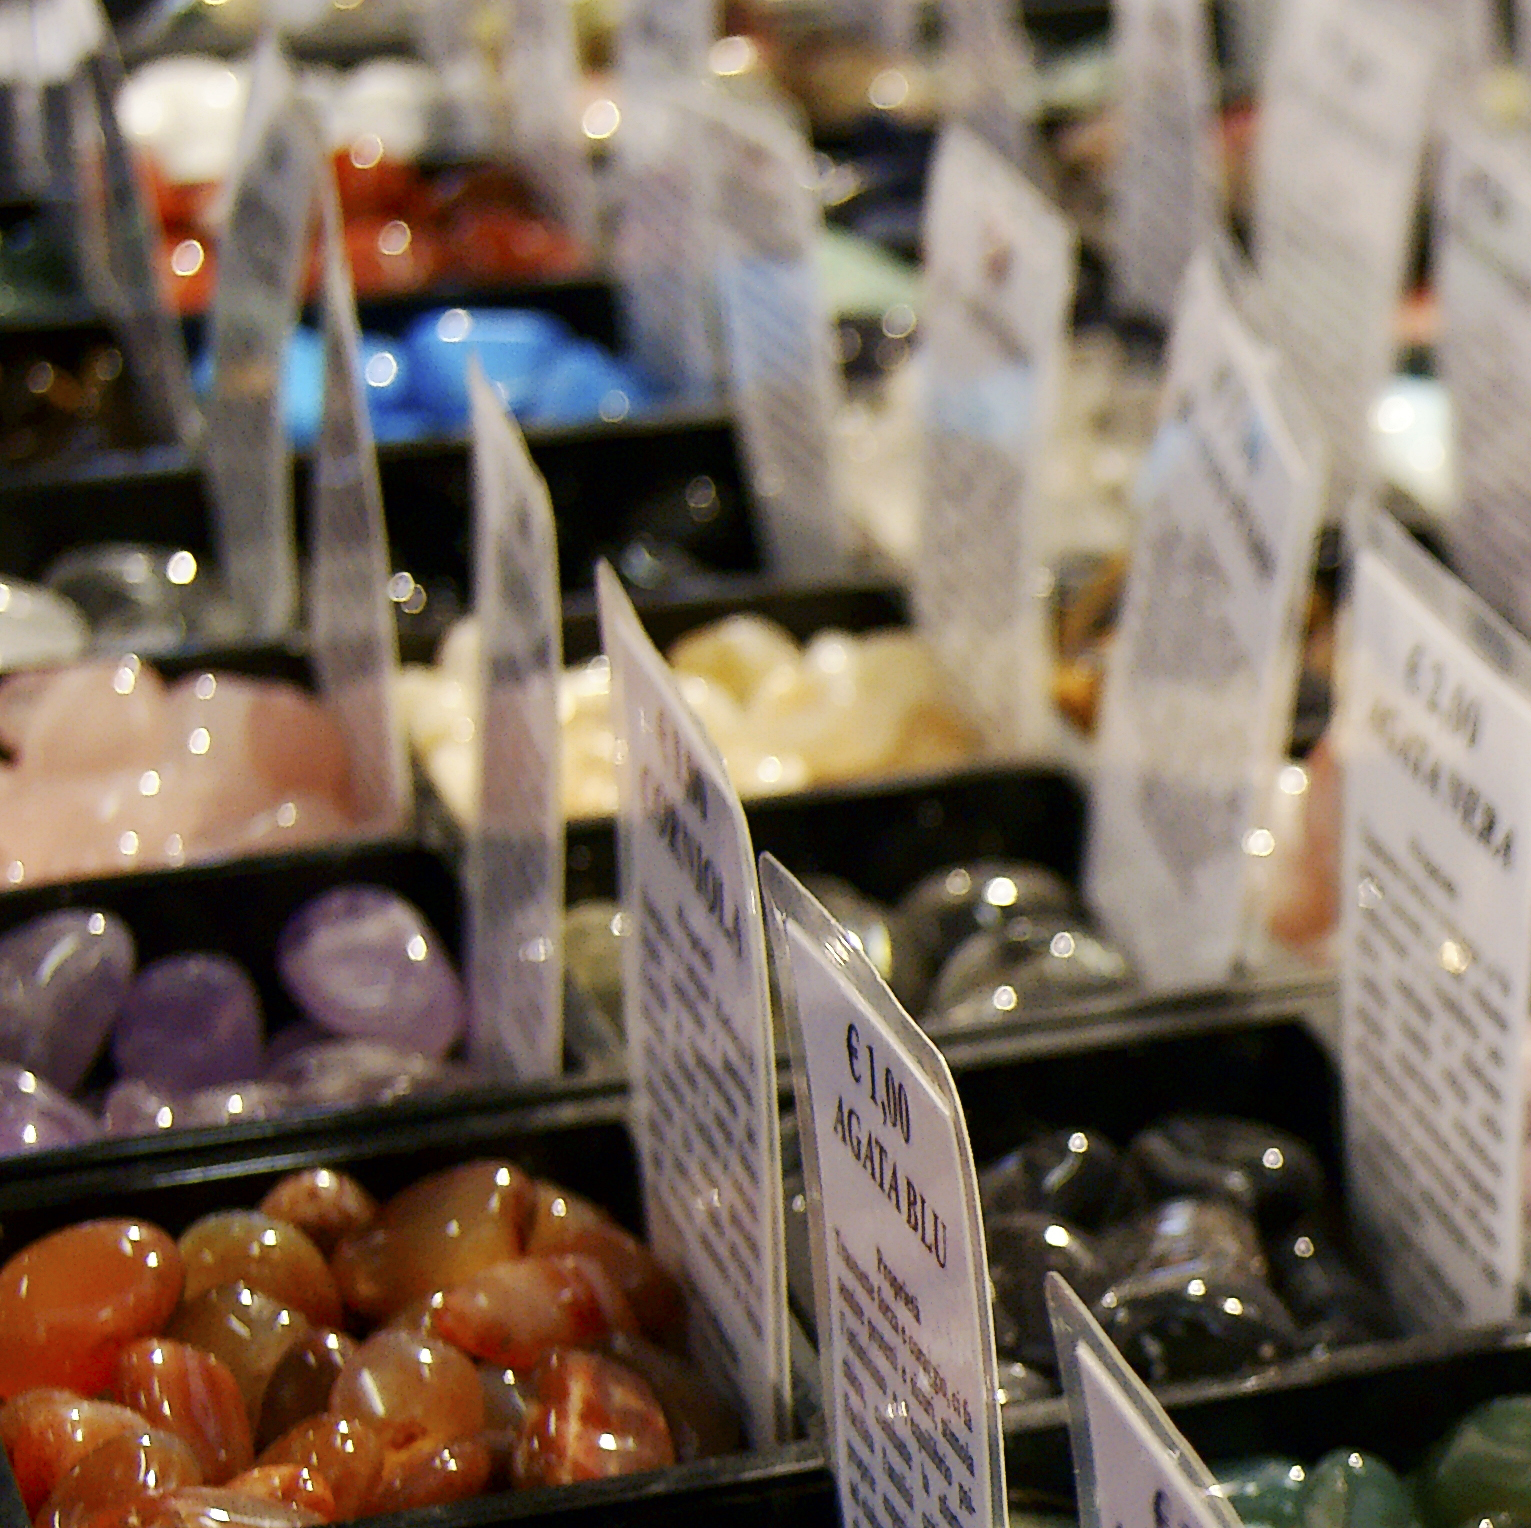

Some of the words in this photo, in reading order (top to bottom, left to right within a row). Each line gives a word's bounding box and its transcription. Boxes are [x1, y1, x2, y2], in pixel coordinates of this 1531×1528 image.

[844, 1021, 862, 1085] €
[864, 1043, 911, 1145] 1,00
[832, 1093, 902, 1214] AGATA
[903, 1174, 947, 1271] BLU
